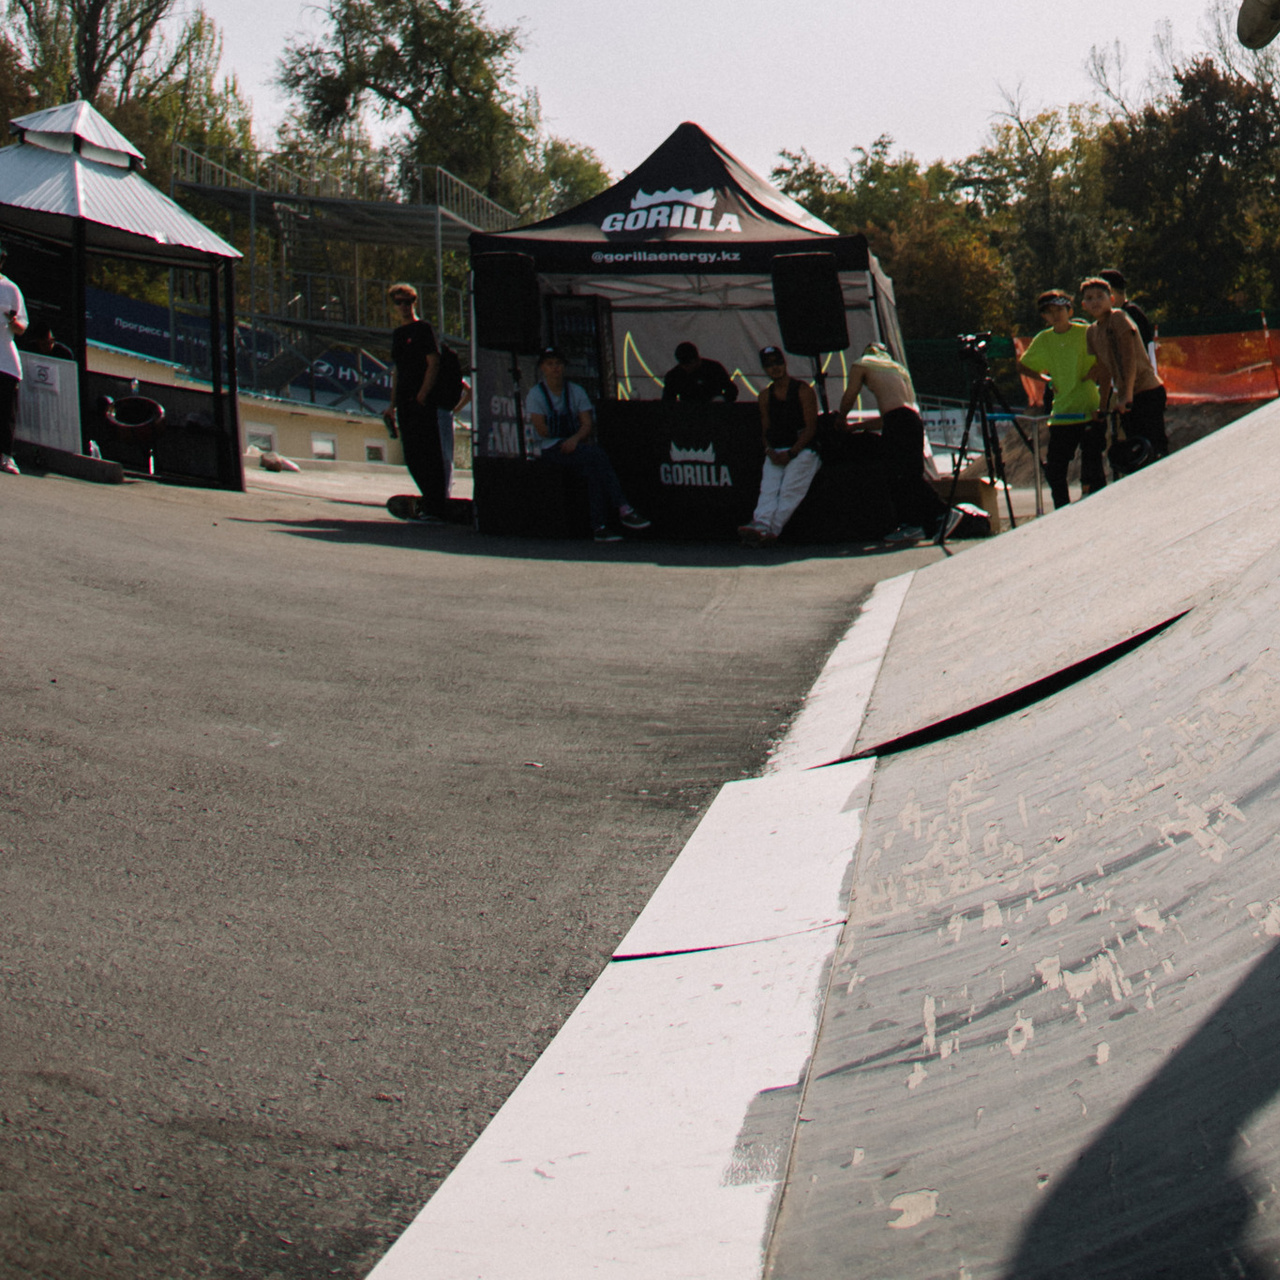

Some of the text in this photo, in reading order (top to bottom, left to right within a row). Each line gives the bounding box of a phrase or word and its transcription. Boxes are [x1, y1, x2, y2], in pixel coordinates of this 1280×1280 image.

[600, 204, 742, 232] GORILLA
[591, 251, 741, 263] @gorillaenergy.kz
[114, 317, 161, 338] Прогресс
[660, 463, 733, 486] GORILLA
